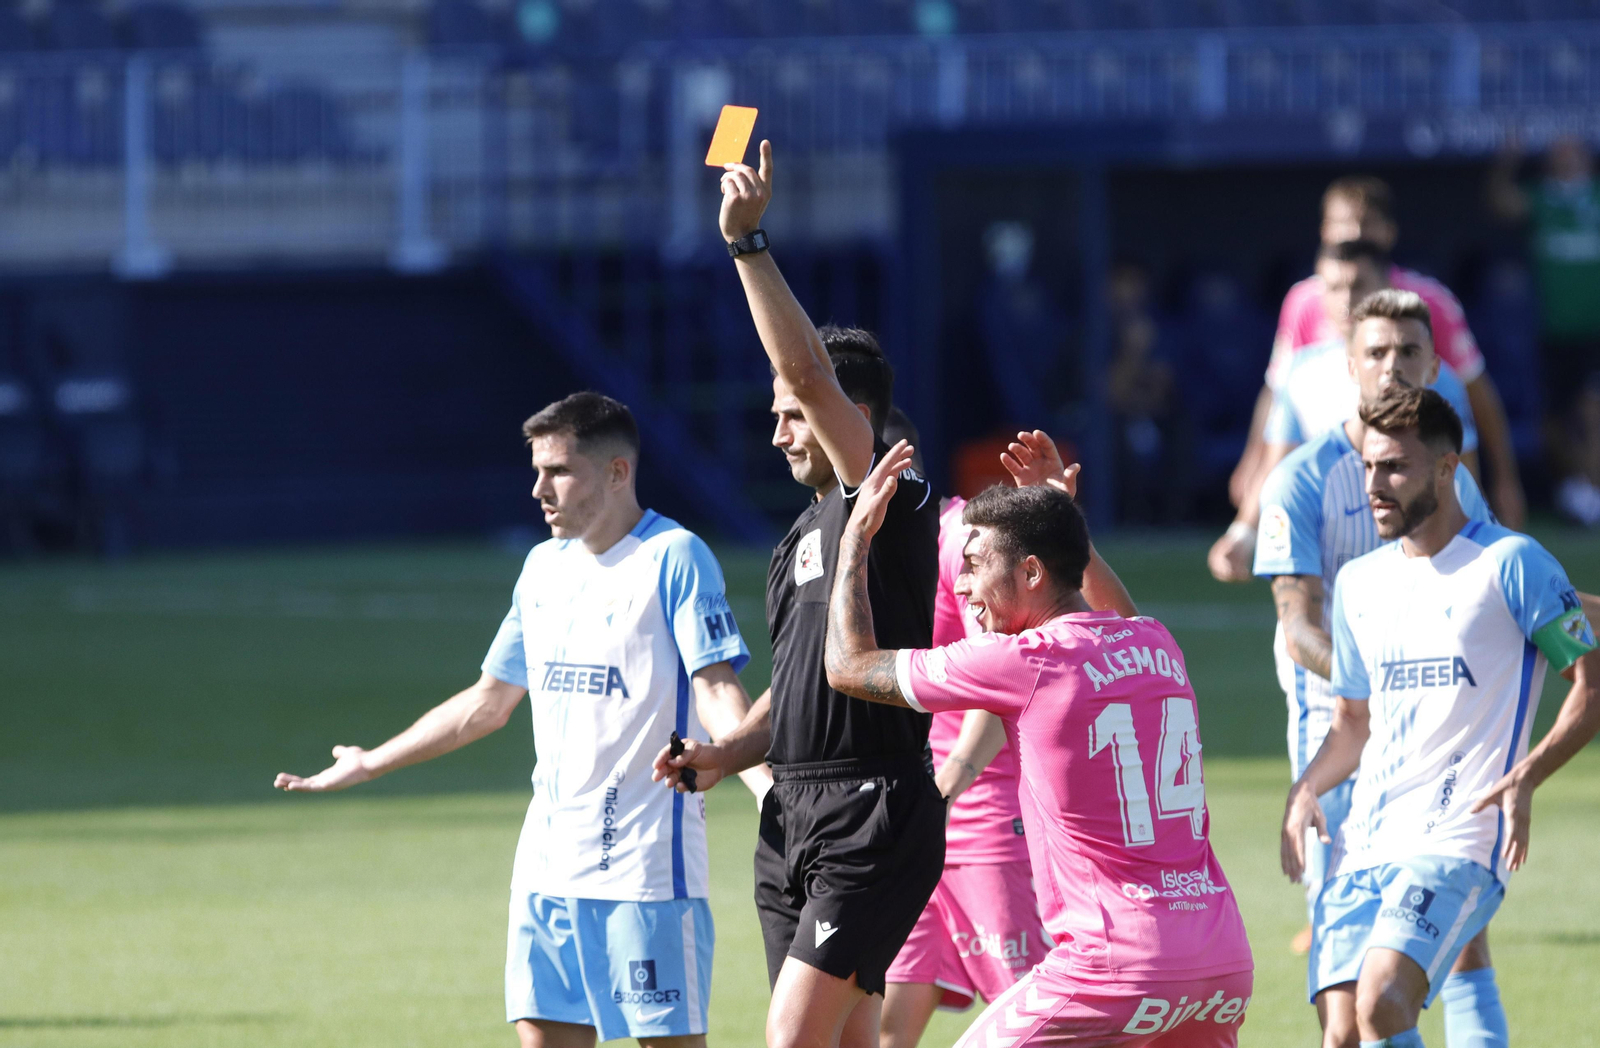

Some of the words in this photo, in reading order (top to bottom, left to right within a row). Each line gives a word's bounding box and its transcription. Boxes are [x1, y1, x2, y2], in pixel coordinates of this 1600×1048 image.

[541, 661, 630, 699] TESESA
[1082, 646, 1185, 692] A.LEMOS
[1380, 656, 1477, 692] TESESA
[1088, 697, 1206, 848] 14
[1161, 869, 1203, 888] Islas
